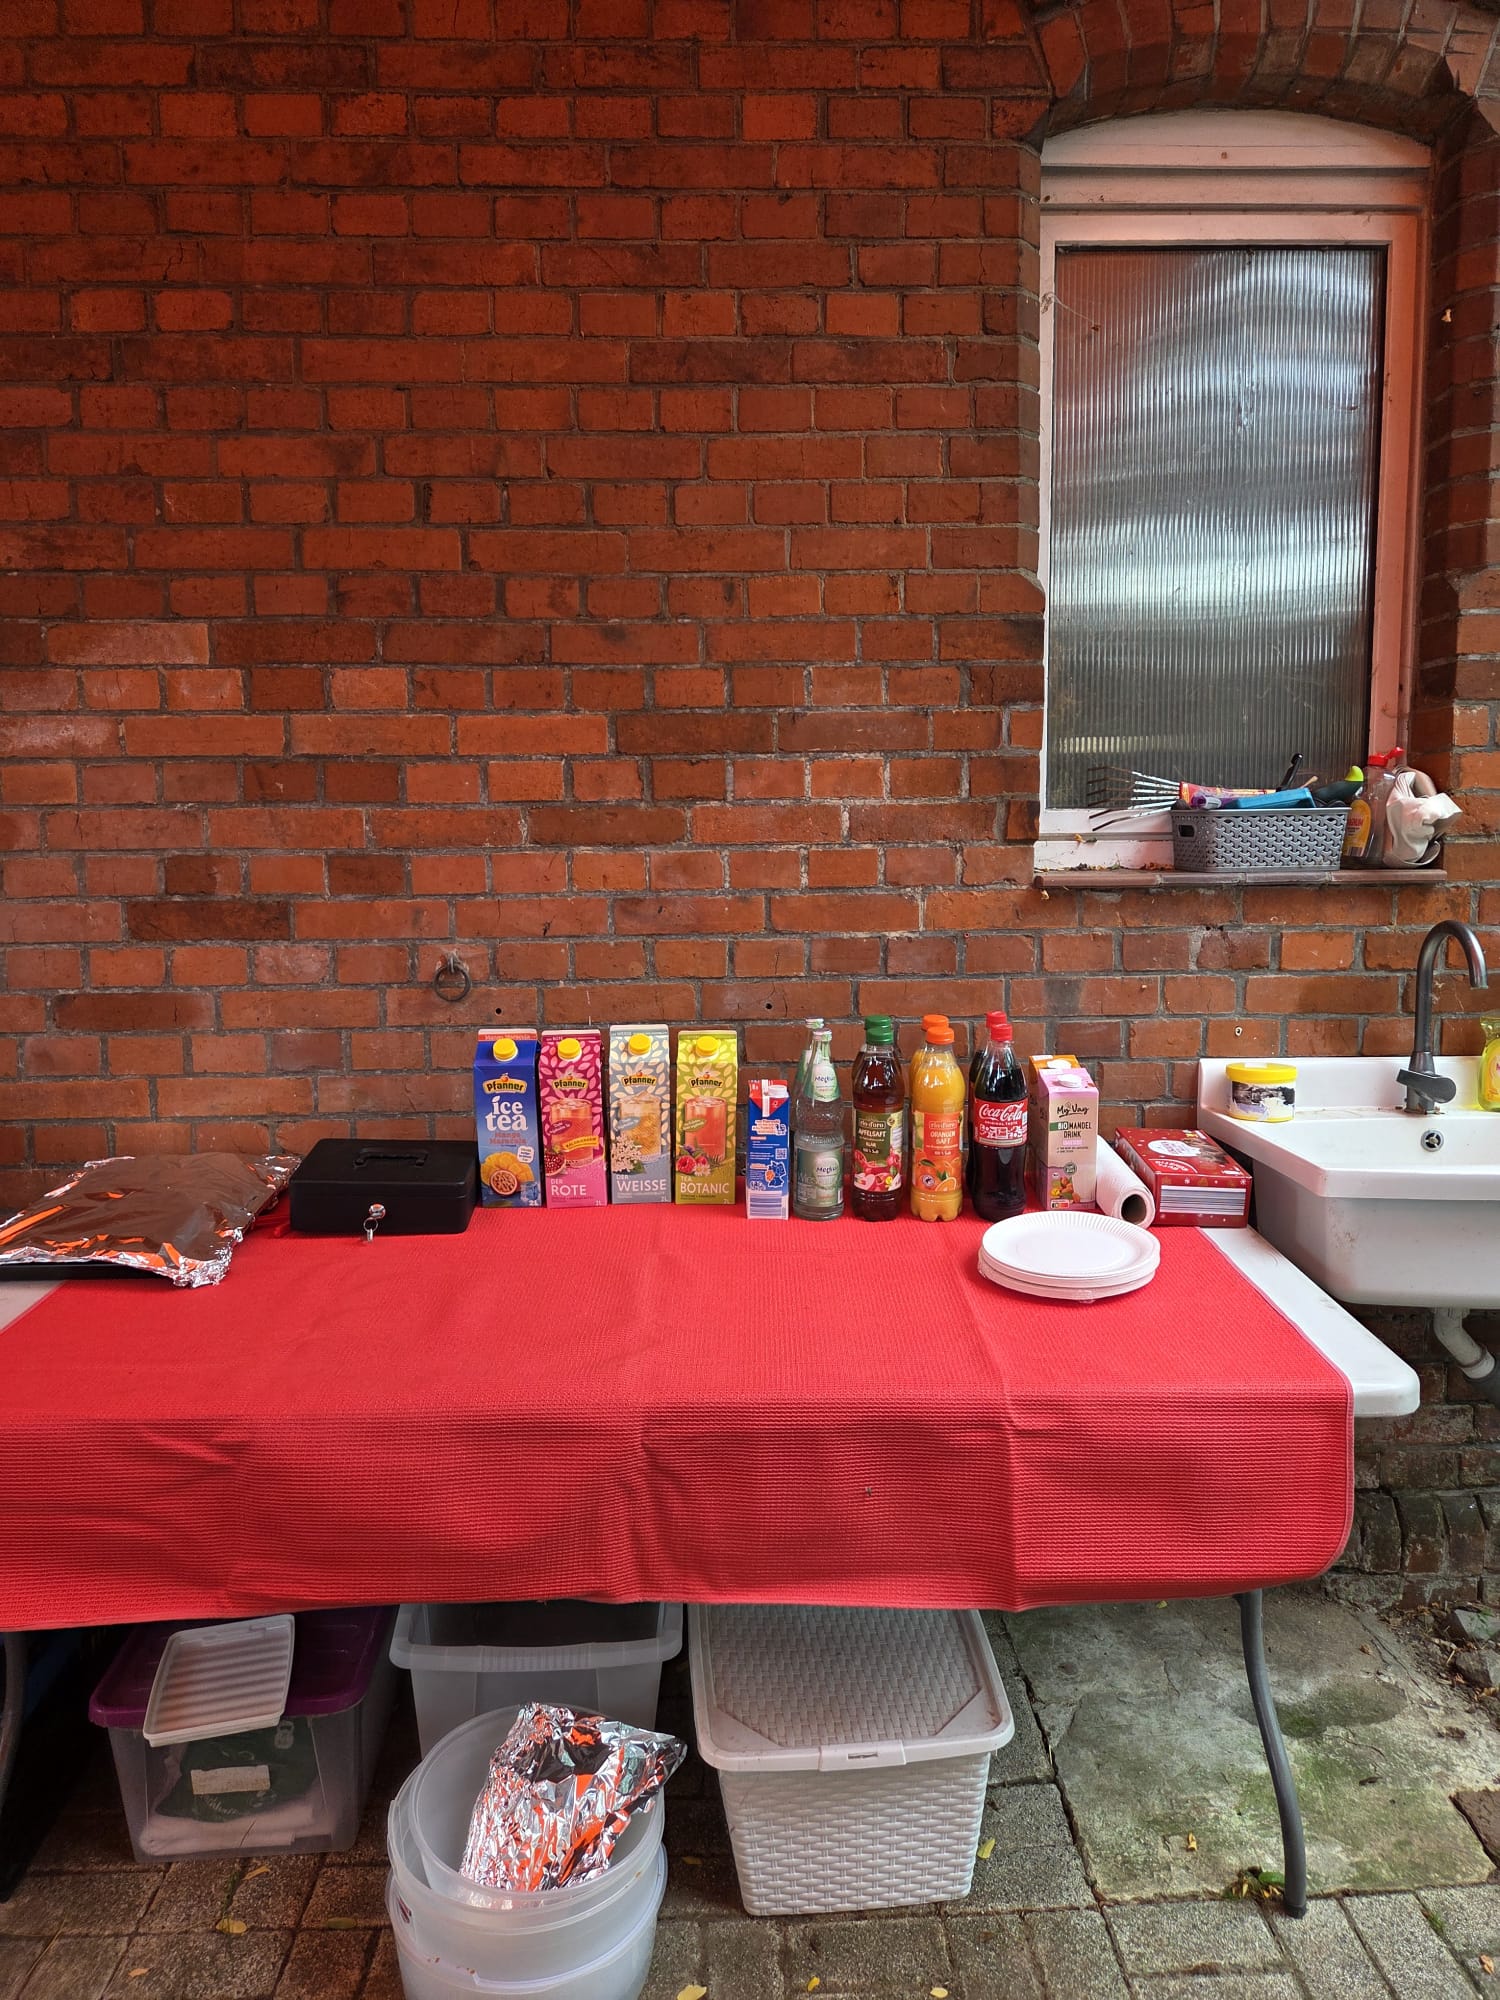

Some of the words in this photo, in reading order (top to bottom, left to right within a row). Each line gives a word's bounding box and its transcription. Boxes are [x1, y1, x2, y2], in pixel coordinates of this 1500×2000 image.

[487, 1081, 524, 1092] pfanner
[554, 1080, 586, 1089] pfanner
[624, 1076, 656, 1086] pfanner
[691, 1078, 722, 1087] pfanner
[492, 1095, 523, 1115] ice
[1057, 1105, 1071, 1116] My
[979, 1103, 1025, 1122] Coca-Cola
[485, 1112, 529, 1131] tea
[1057, 1121, 1068, 1130] BIO
[1069, 1121, 1092, 1130] MANDEL
[858, 1128, 886, 1138] APFELSAFT
[930, 1130, 956, 1138] ORANGEN
[1063, 1130, 1082, 1139] DRINK
[551, 1184, 587, 1196] ROTE
[617, 1179, 667, 1192] WEISSE
[680, 1182, 730, 1194] BOTANIC
